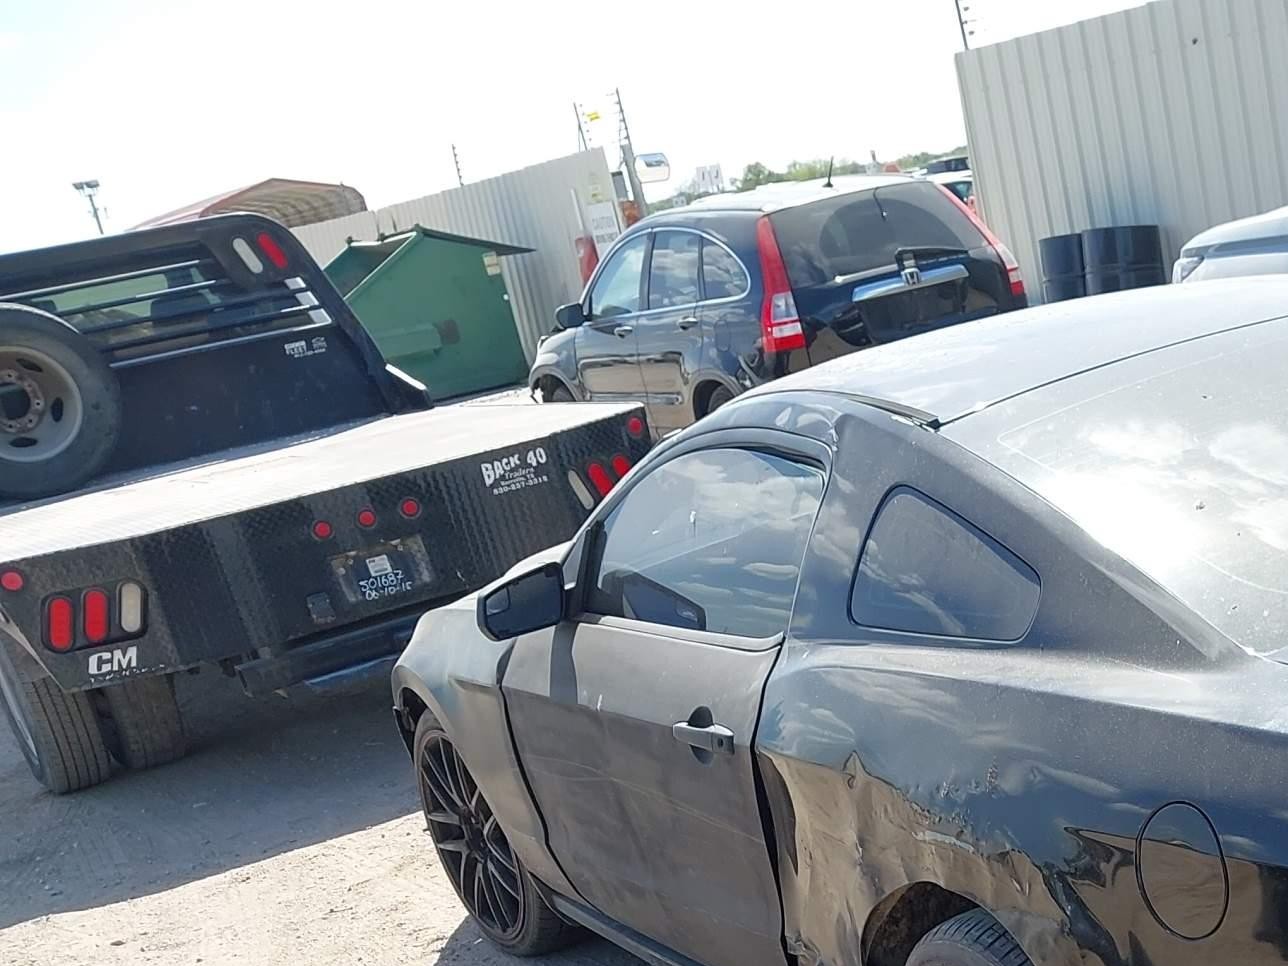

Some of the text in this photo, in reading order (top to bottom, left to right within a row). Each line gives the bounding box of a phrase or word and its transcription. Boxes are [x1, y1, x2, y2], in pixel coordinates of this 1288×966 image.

[480, 447, 547, 488] BACK 40
[88, 645, 138, 675] CM
